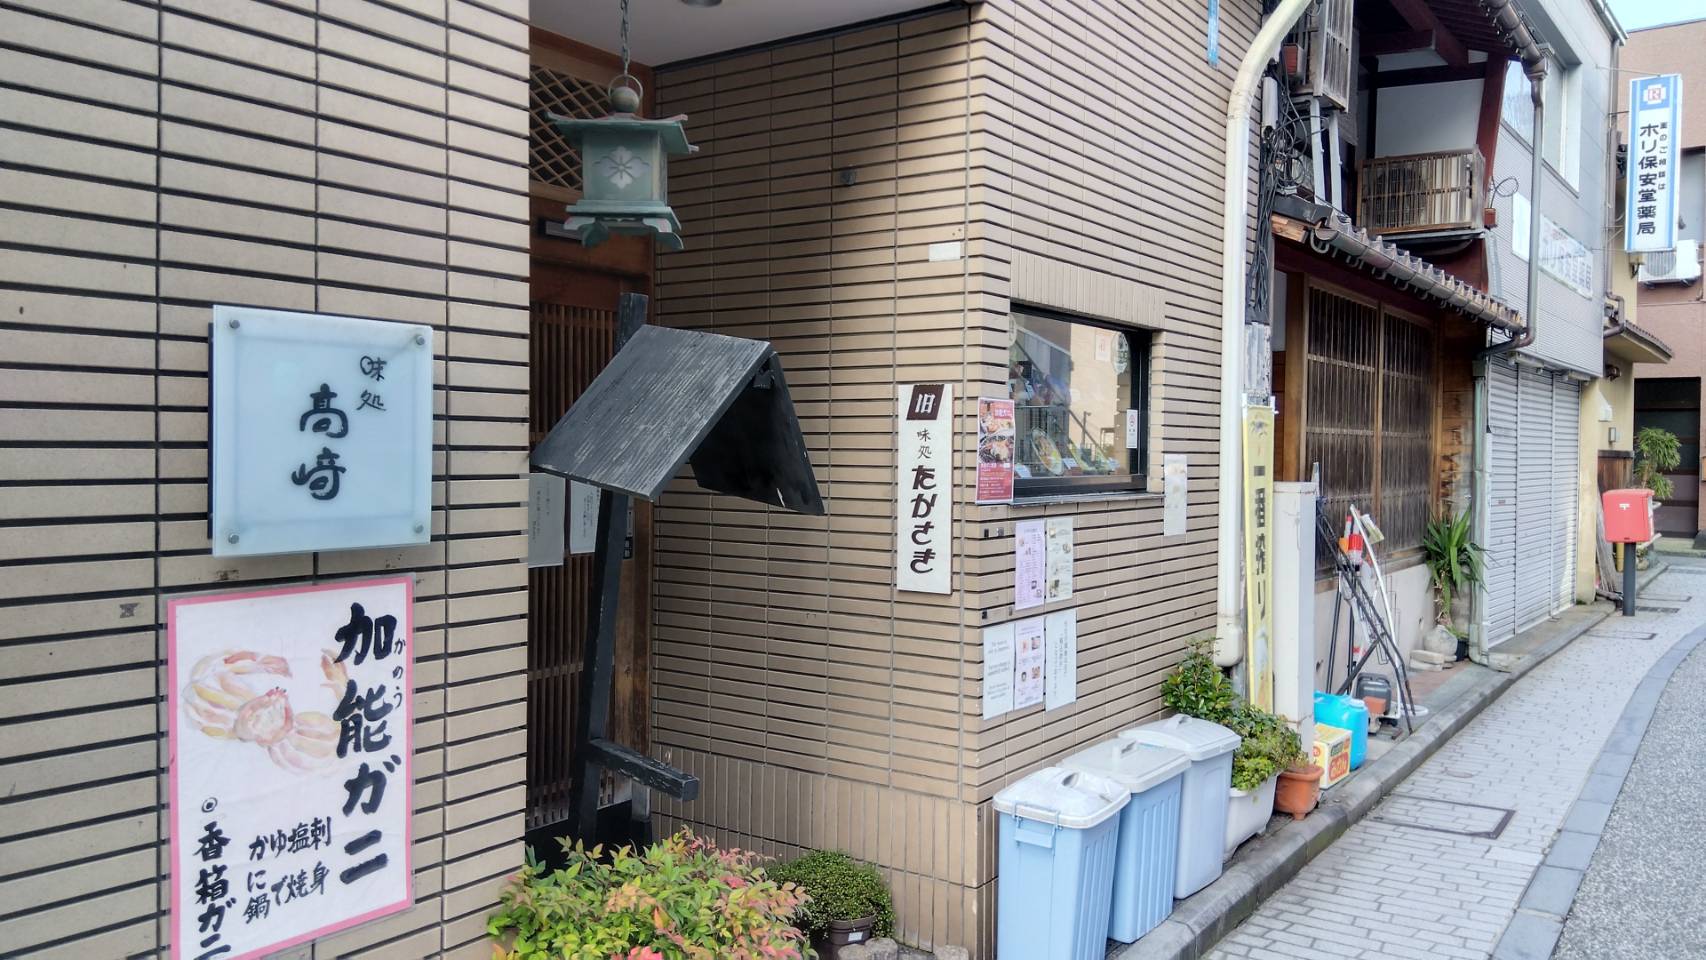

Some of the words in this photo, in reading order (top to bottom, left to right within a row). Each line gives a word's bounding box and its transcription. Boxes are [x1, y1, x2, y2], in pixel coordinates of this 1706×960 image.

[1637, 123, 1659, 236] ホリ保安堂薬局
[356, 355, 387, 411] 味処
[915, 393, 936, 414] 旧
[916, 428, 932, 460] 味処
[910, 465, 938, 574] たかさき
[392, 638, 406, 710] かのう
[333, 602, 402, 884] 加能ガニ
[242, 835, 270, 924] かに鍋
[270, 829, 288, 906] ゆで
[310, 816, 332, 895] 刺身
